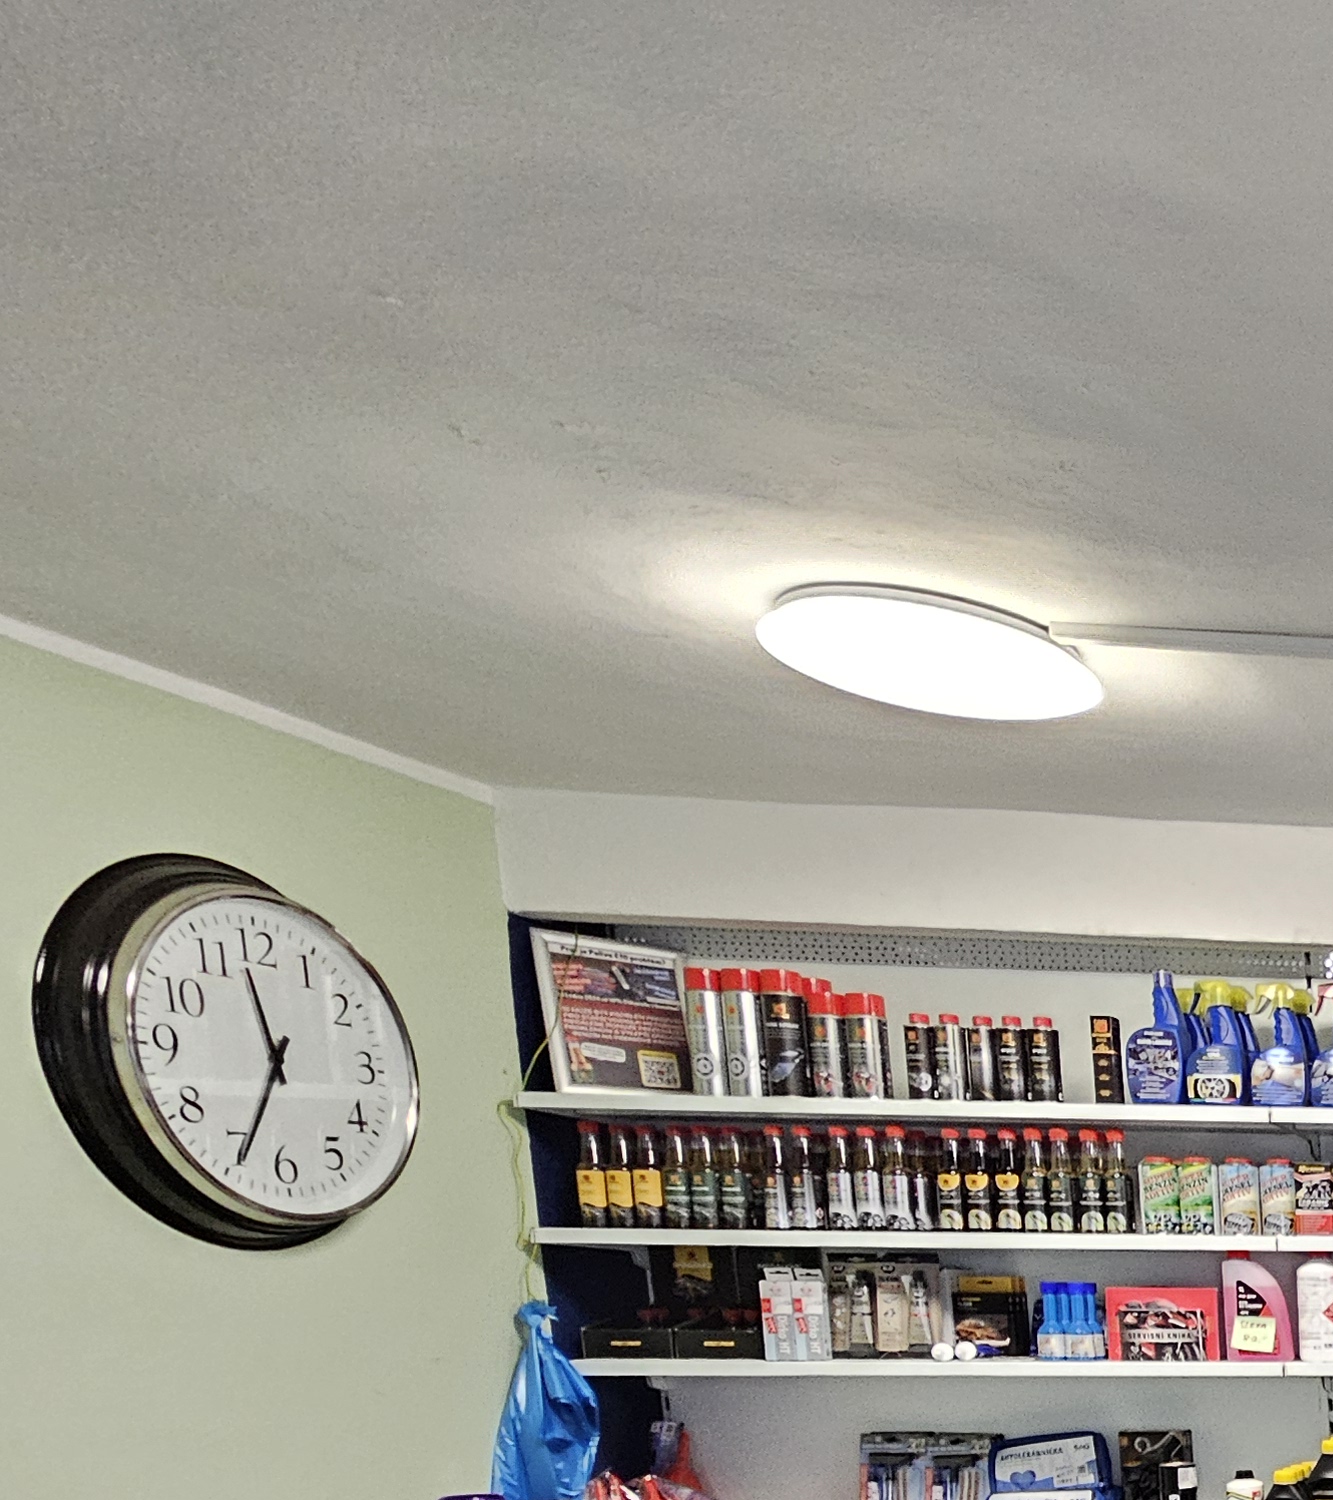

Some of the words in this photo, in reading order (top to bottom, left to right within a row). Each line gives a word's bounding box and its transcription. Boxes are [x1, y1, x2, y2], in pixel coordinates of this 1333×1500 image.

[198, 937, 233, 978] 11
[236, 928, 277, 968] 12
[297, 954, 315, 989] 1
[163, 976, 205, 1018] 10
[332, 993, 352, 1027] 2
[152, 1023, 179, 1065] 9
[354, 1051, 376, 1085] 3
[179, 1085, 205, 1123] 8
[347, 1099, 369, 1133] 4
[226, 1130, 249, 1166] 7
[274, 1145, 298, 1184] 6
[323, 1136, 344, 1171] 5
[1127, 1332, 1164, 1340] SERVISNÍ
[1167, 1332, 1192, 1340] KNIHA
